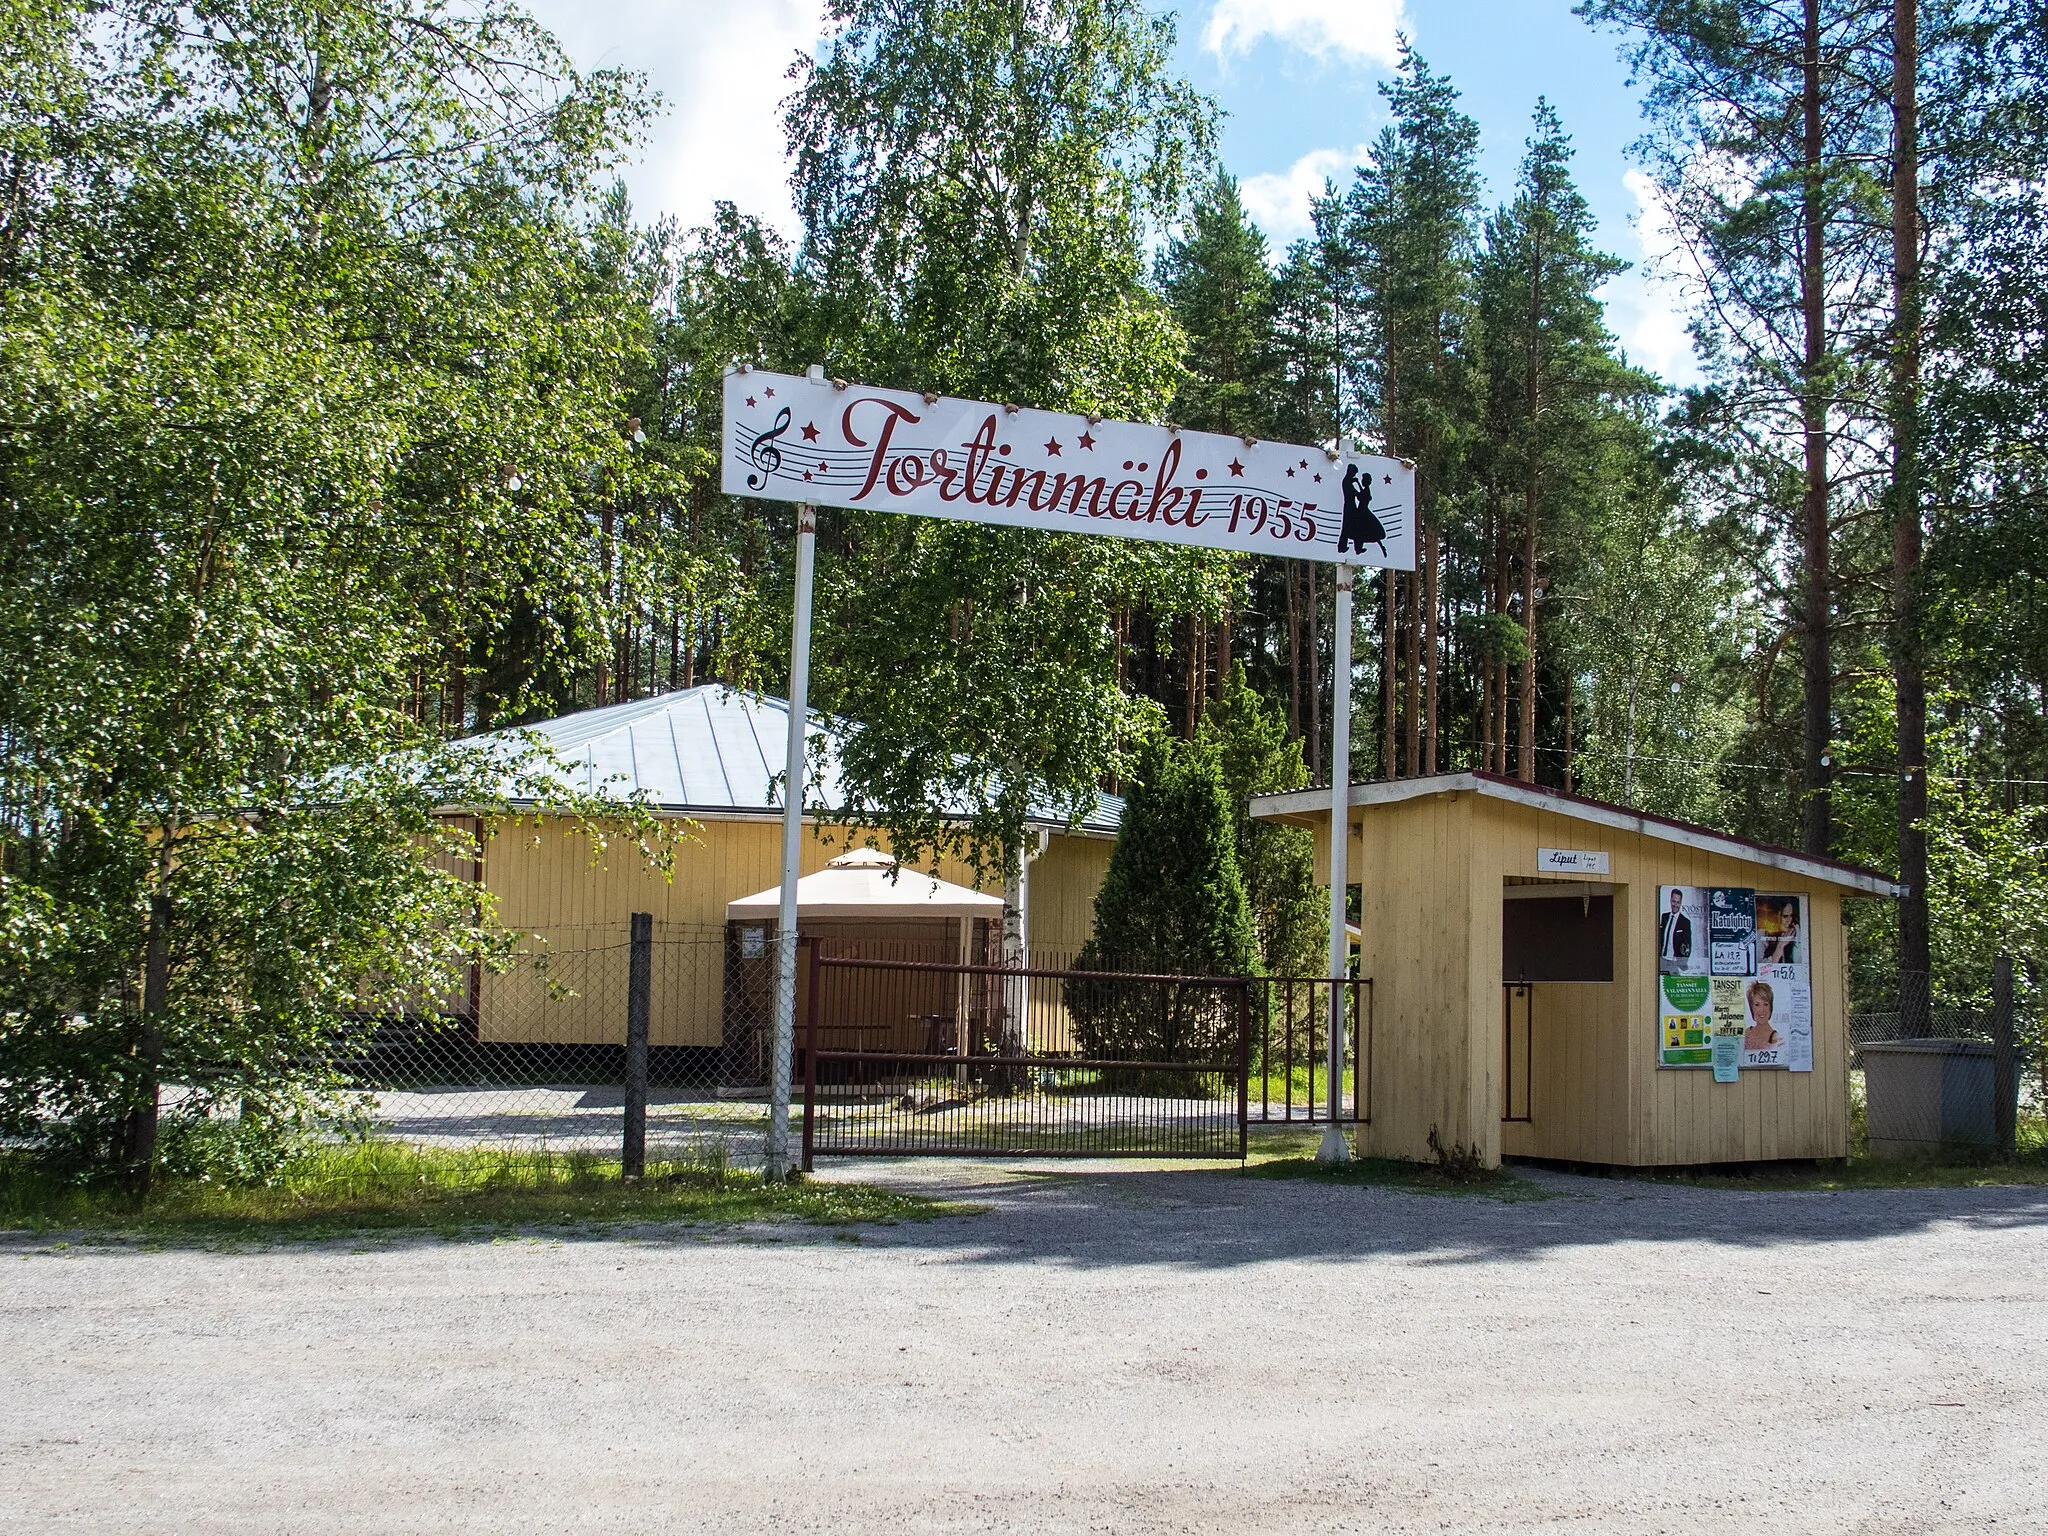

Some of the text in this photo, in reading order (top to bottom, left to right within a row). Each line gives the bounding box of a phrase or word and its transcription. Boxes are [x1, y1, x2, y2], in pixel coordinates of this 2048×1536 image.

[841, 397, 1319, 542] Tortinmäki 1955
[1549, 851, 1578, 866] Liput
[1711, 911, 1753, 933] Katulyhty
[1715, 950, 1724, 959] LA
[1772, 969, 1780, 979] TI
[1713, 980, 1742, 989] TANSSIT
[1748, 1053, 1757, 1063] TI
